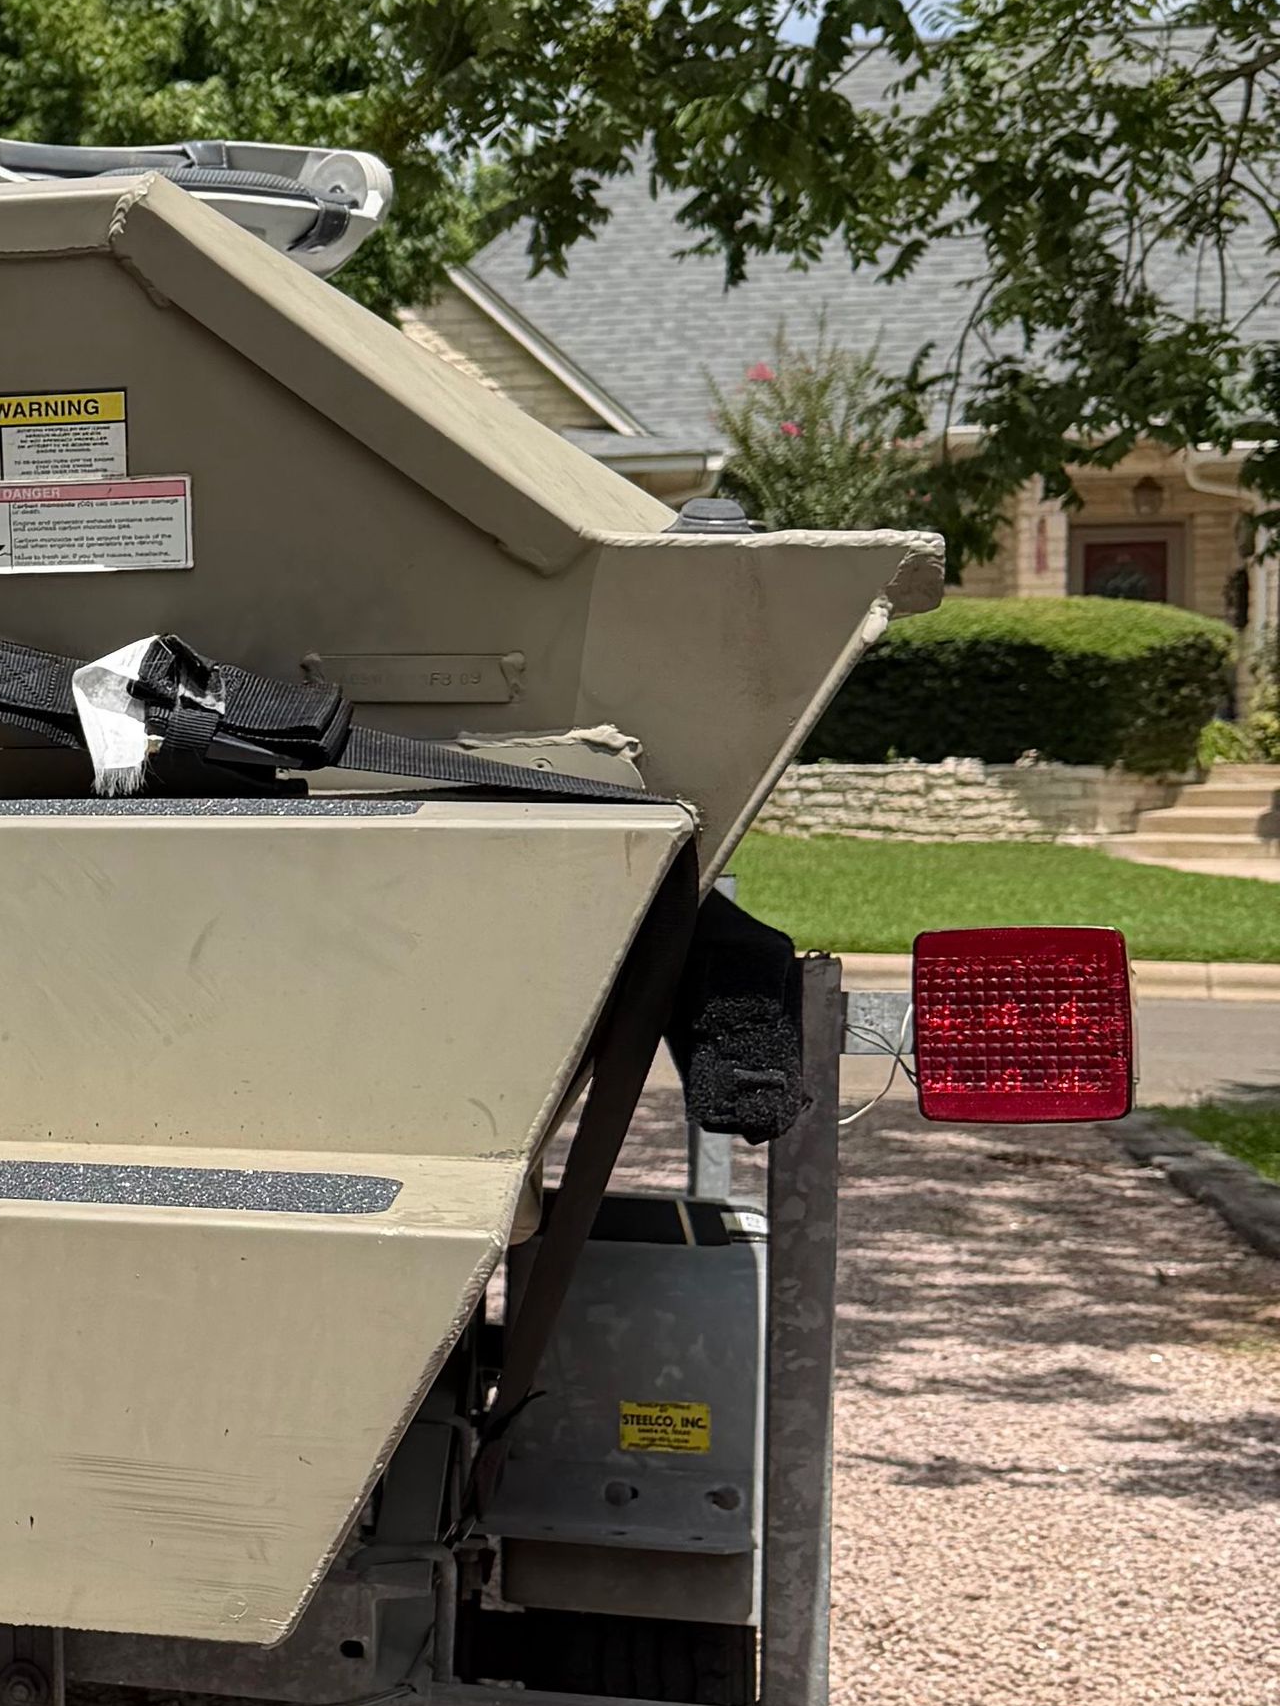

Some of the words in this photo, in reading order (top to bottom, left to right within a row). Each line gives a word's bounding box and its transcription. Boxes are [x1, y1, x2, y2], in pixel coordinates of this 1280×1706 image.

[3, 487, 61, 501] DANGER
[623, 1413, 677, 1429] STEELCO,
[681, 1416, 708, 1430] INC.
